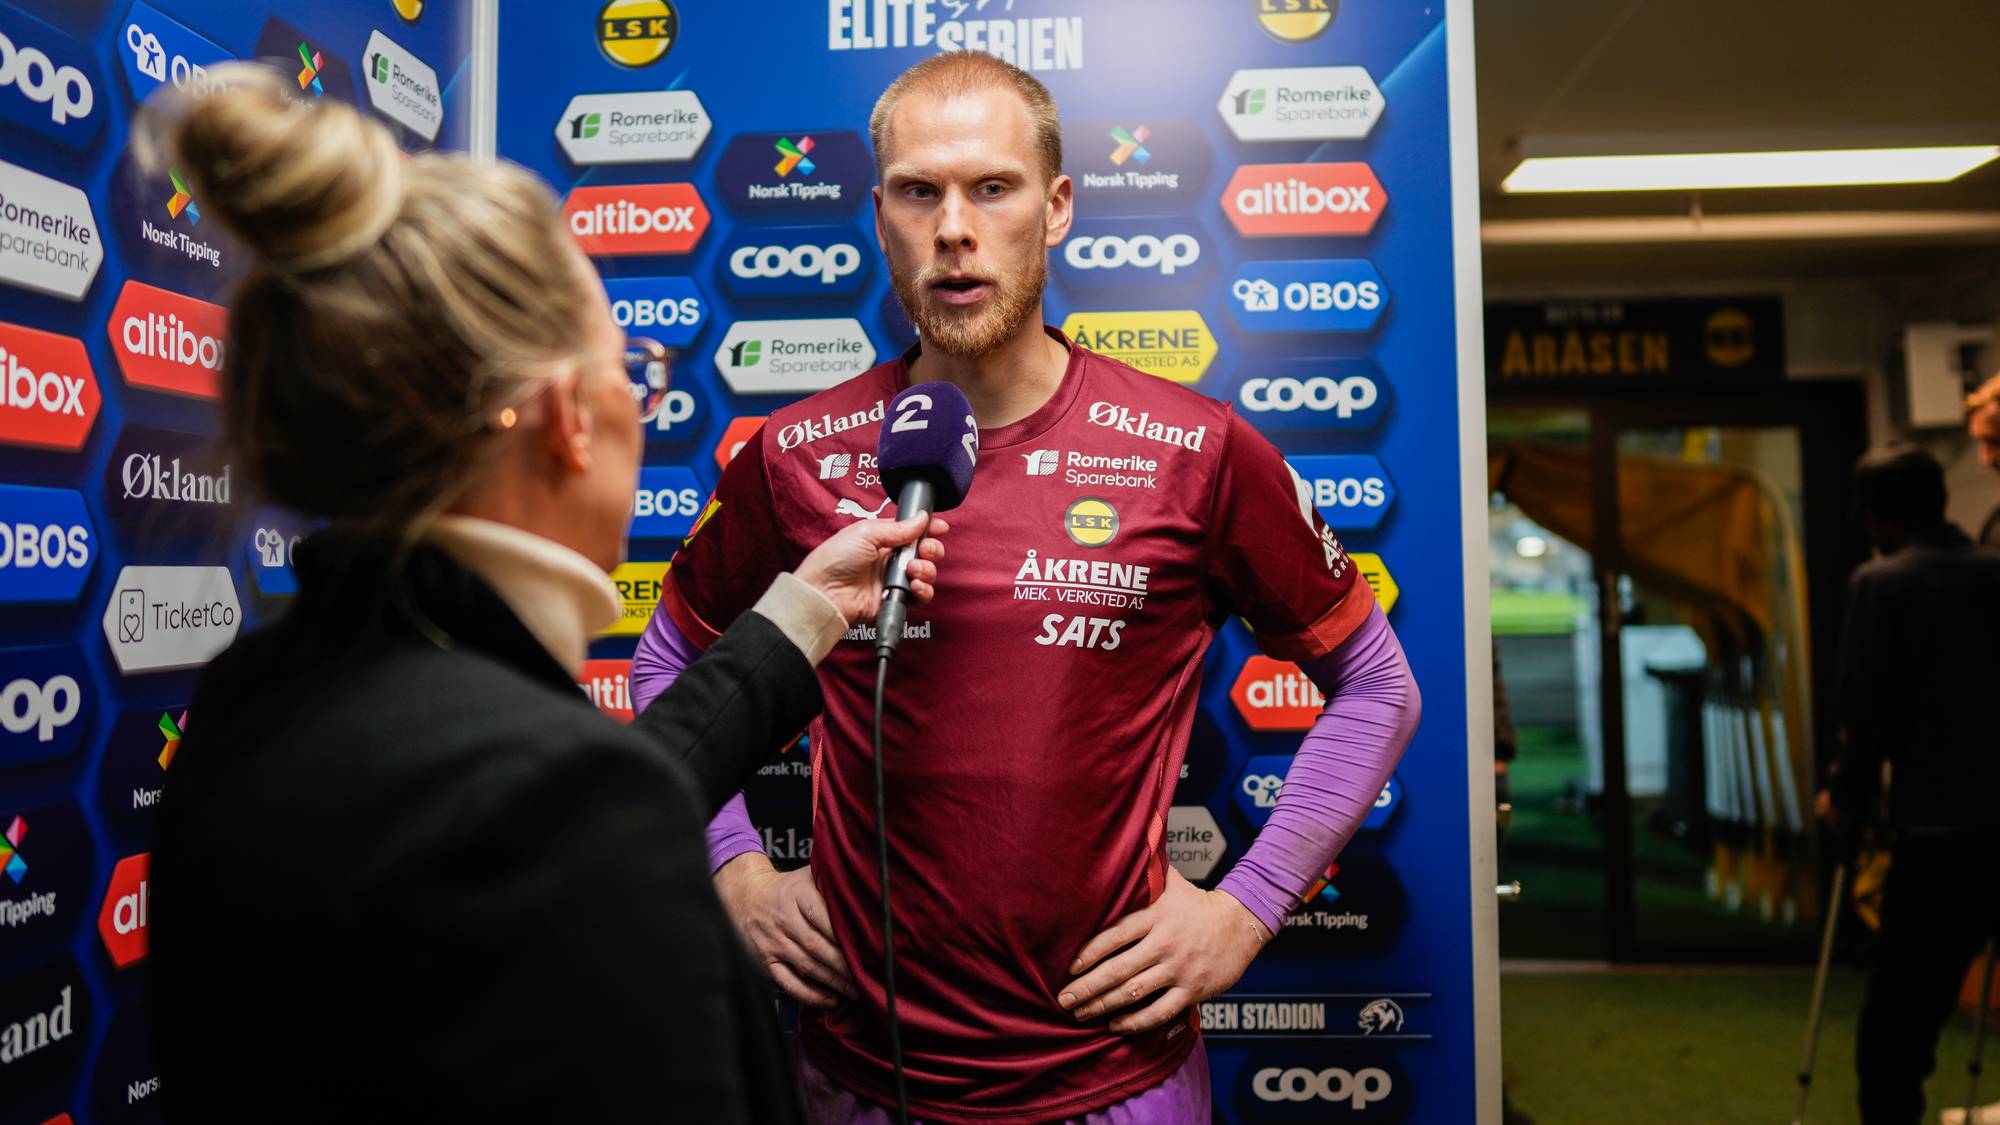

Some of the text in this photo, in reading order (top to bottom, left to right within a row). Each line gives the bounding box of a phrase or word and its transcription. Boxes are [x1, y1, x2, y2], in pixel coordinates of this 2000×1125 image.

[605, 20, 668, 38] LSK
[828, 0, 936, 50] ELITE
[937, 17, 1083, 70] SERIEN
[393, 64, 438, 107] Romerike
[1276, 87, 1371, 104] Romerike
[391, 84, 437, 122] Sparebank
[1276, 106, 1371, 123] Sparebank
[610, 110, 699, 127] Romerike
[609, 129, 697, 147] Sparebank
[749, 182, 841, 199] Norsk Tipping
[1083, 172, 1178, 189] Norsk Tipping
[1236, 178, 1371, 215] altibox
[571, 199, 695, 236] altibox
[0, 232, 88, 273] parebank
[142, 219, 220, 267] Norsk Tipping
[1065, 234, 1200, 275] coop
[730, 243, 861, 284] coop
[1284, 281, 1380, 311] OBOS
[612, 298, 700, 327] OBOS
[771, 338, 863, 355] Romerike
[1073, 325, 1200, 350] ÅKRENE
[770, 357, 862, 376] Sparebank
[1181, 356, 1200, 367] AS
[0, 346, 85, 417] ibox
[1240, 376, 1378, 418] coop
[777, 399, 885, 453] Økland
[891, 394, 933, 433] 2
[1088, 402, 1206, 452] Økland
[1066, 451, 1158, 472] Romerike
[122, 453, 232, 504] Økland
[1065, 469, 1156, 489] Sparebank
[635, 488, 699, 517] BOS
[1071, 516, 1112, 528] LSK
[1015, 549, 1150, 590] ÅKRENE
[615, 580, 663, 600] REN
[1013, 586, 1144, 609] MEK. VERKSTED AS
[152, 601, 234, 631] TicketCo
[1034, 613, 1126, 651] SATS
[0, 675, 80, 742] op
[757, 762, 812, 778] orsk Tip
[133, 787, 163, 809] Nors
[761, 827, 814, 858] kla
[1167, 826, 1213, 843] erike
[1167, 847, 1212, 863] bank
[113, 881, 147, 935] al
[1314, 911, 1368, 930] Tipping
[0, 984, 73, 1064] and
[1242, 1002, 1325, 1030] STADION
[128, 1076, 160, 1104] Nors
[1252, 1067, 1392, 1110] coop
